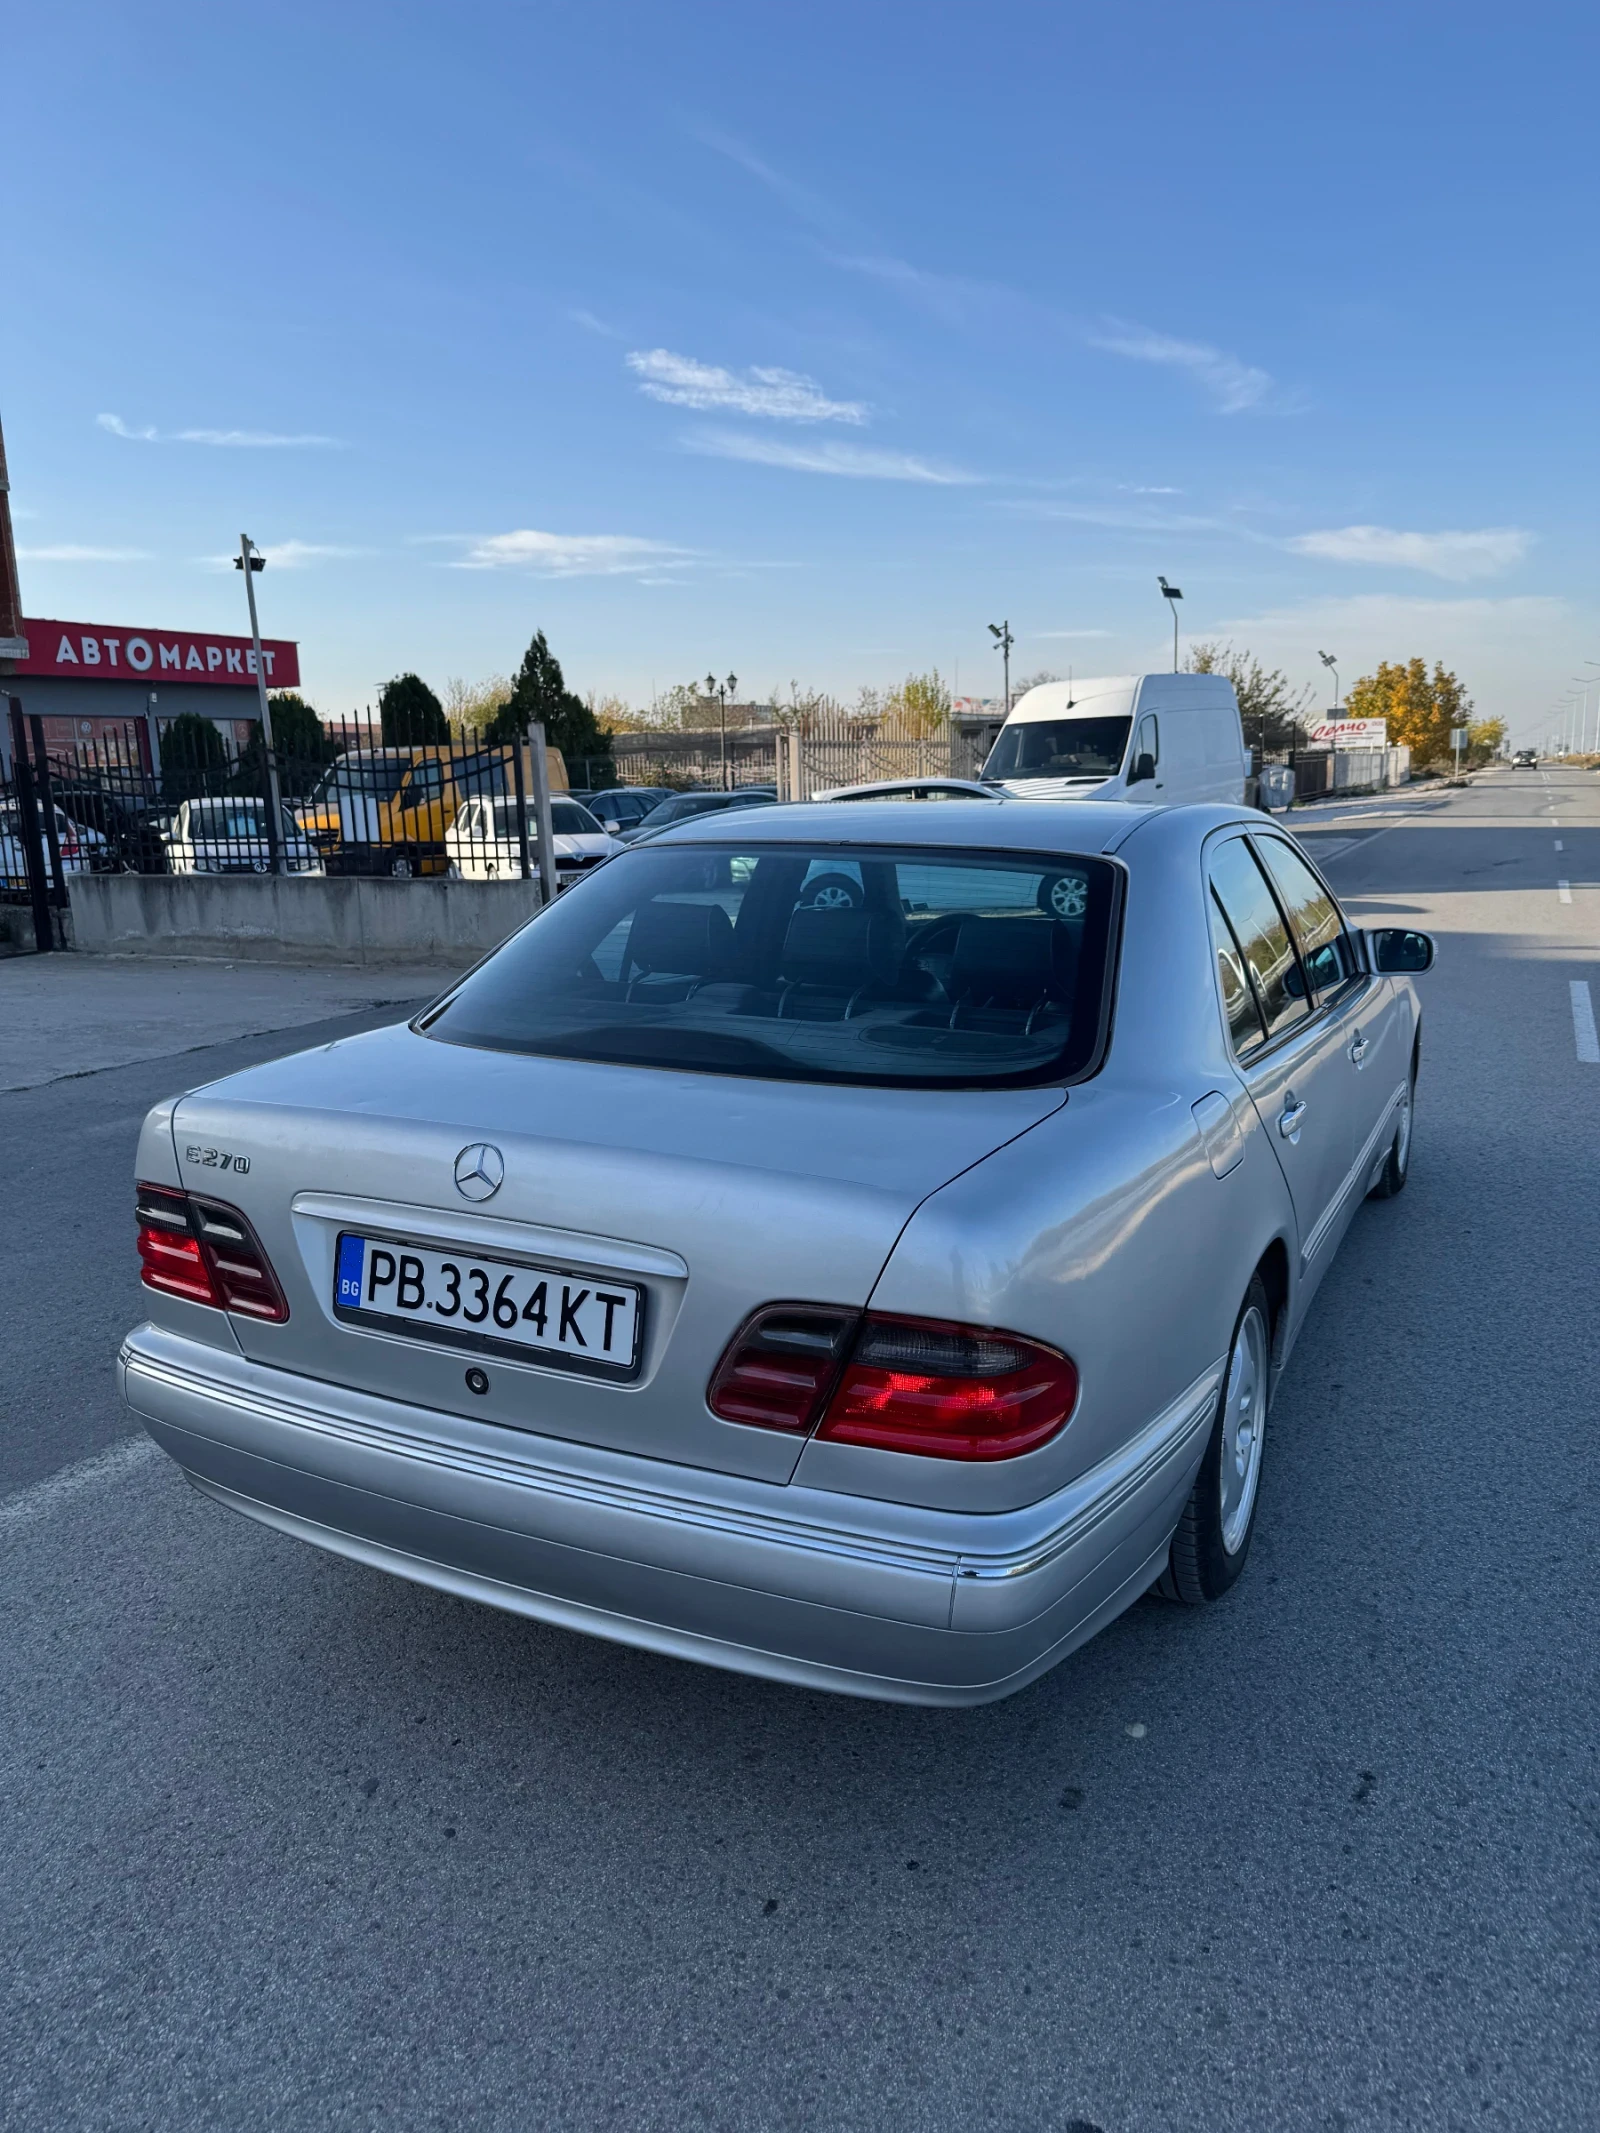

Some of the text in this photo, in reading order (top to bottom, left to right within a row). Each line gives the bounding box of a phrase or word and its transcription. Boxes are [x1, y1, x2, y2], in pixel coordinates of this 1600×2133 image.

[56, 635, 275, 676] АВТОМАРКЕТ
[186, 1145, 251, 1174] E270
[341, 1279, 360, 1297] BG
